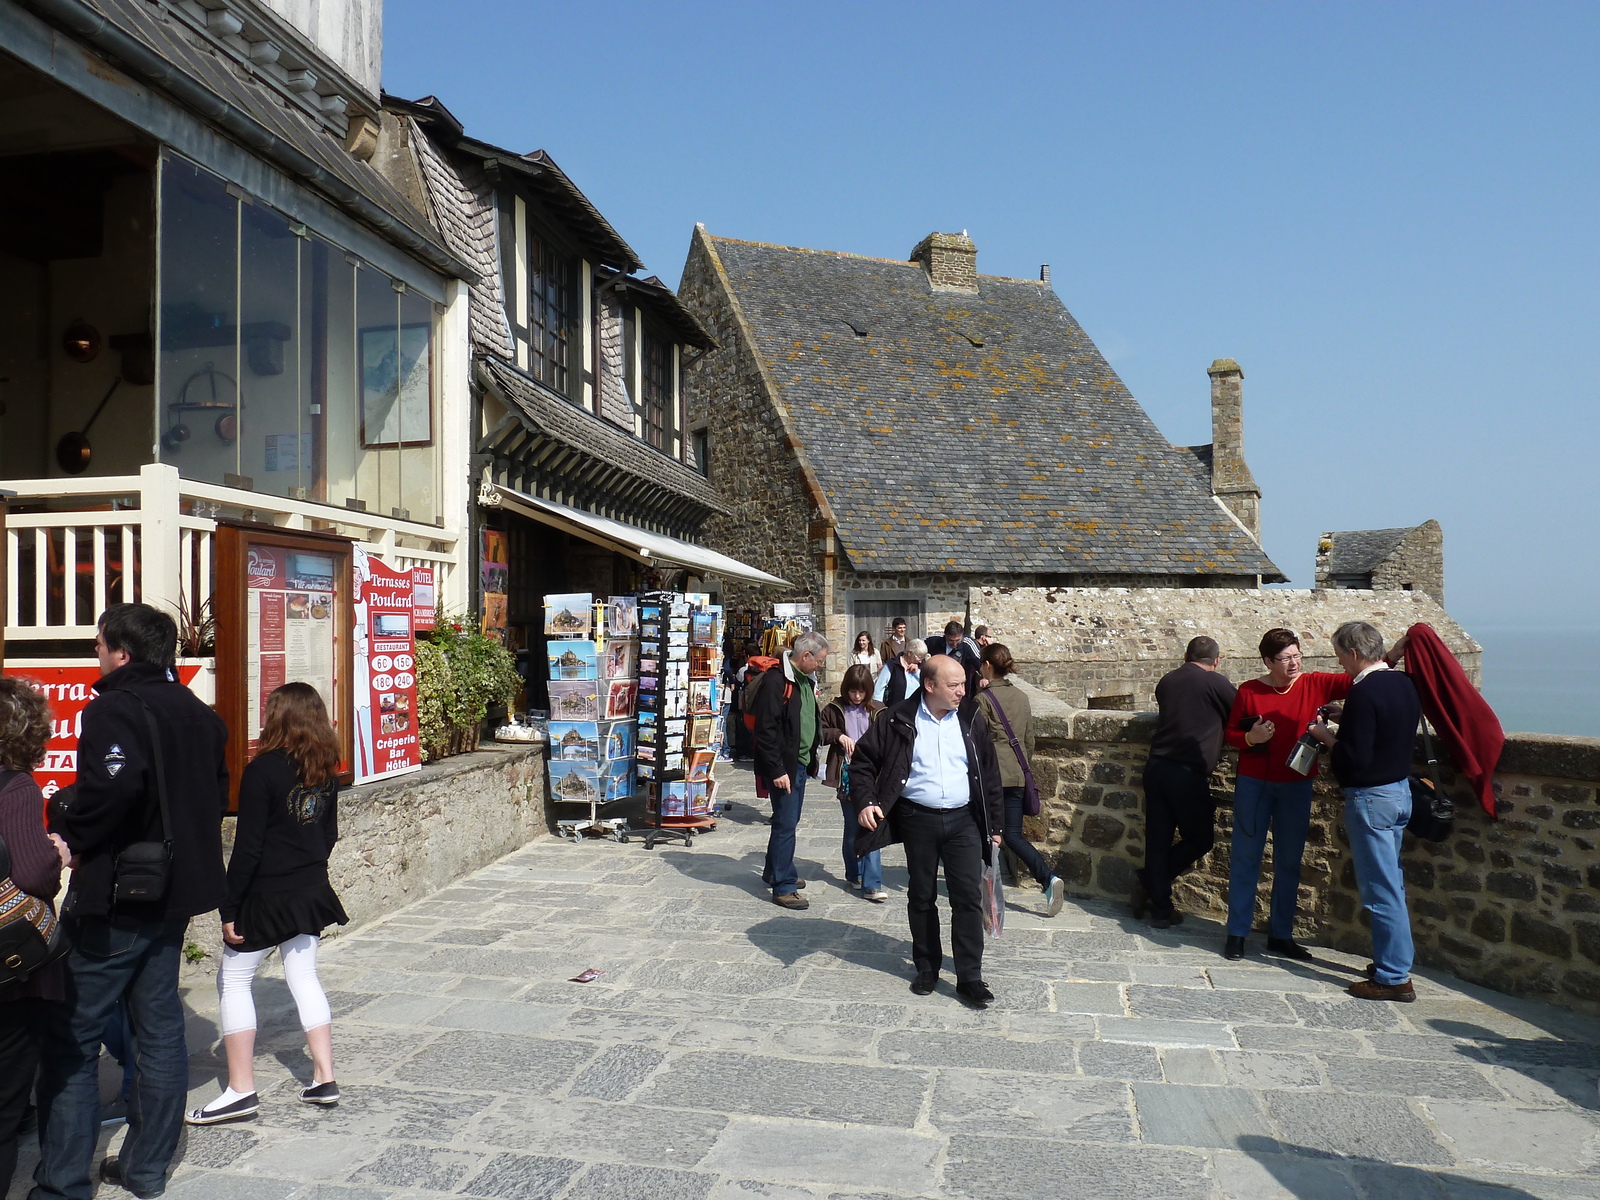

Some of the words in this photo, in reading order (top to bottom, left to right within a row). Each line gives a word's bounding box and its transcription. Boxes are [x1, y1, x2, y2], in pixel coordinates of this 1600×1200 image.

[371, 574, 410, 589] Terrasses
[414, 570, 433, 584] HÔTEL
[369, 591, 413, 608] Poulard
[376, 643, 409, 651] RESTAURANT
[376, 734, 416, 750] Crêperie
[389, 749, 406, 759] Bar
[385, 757, 410, 772] Hôtel
